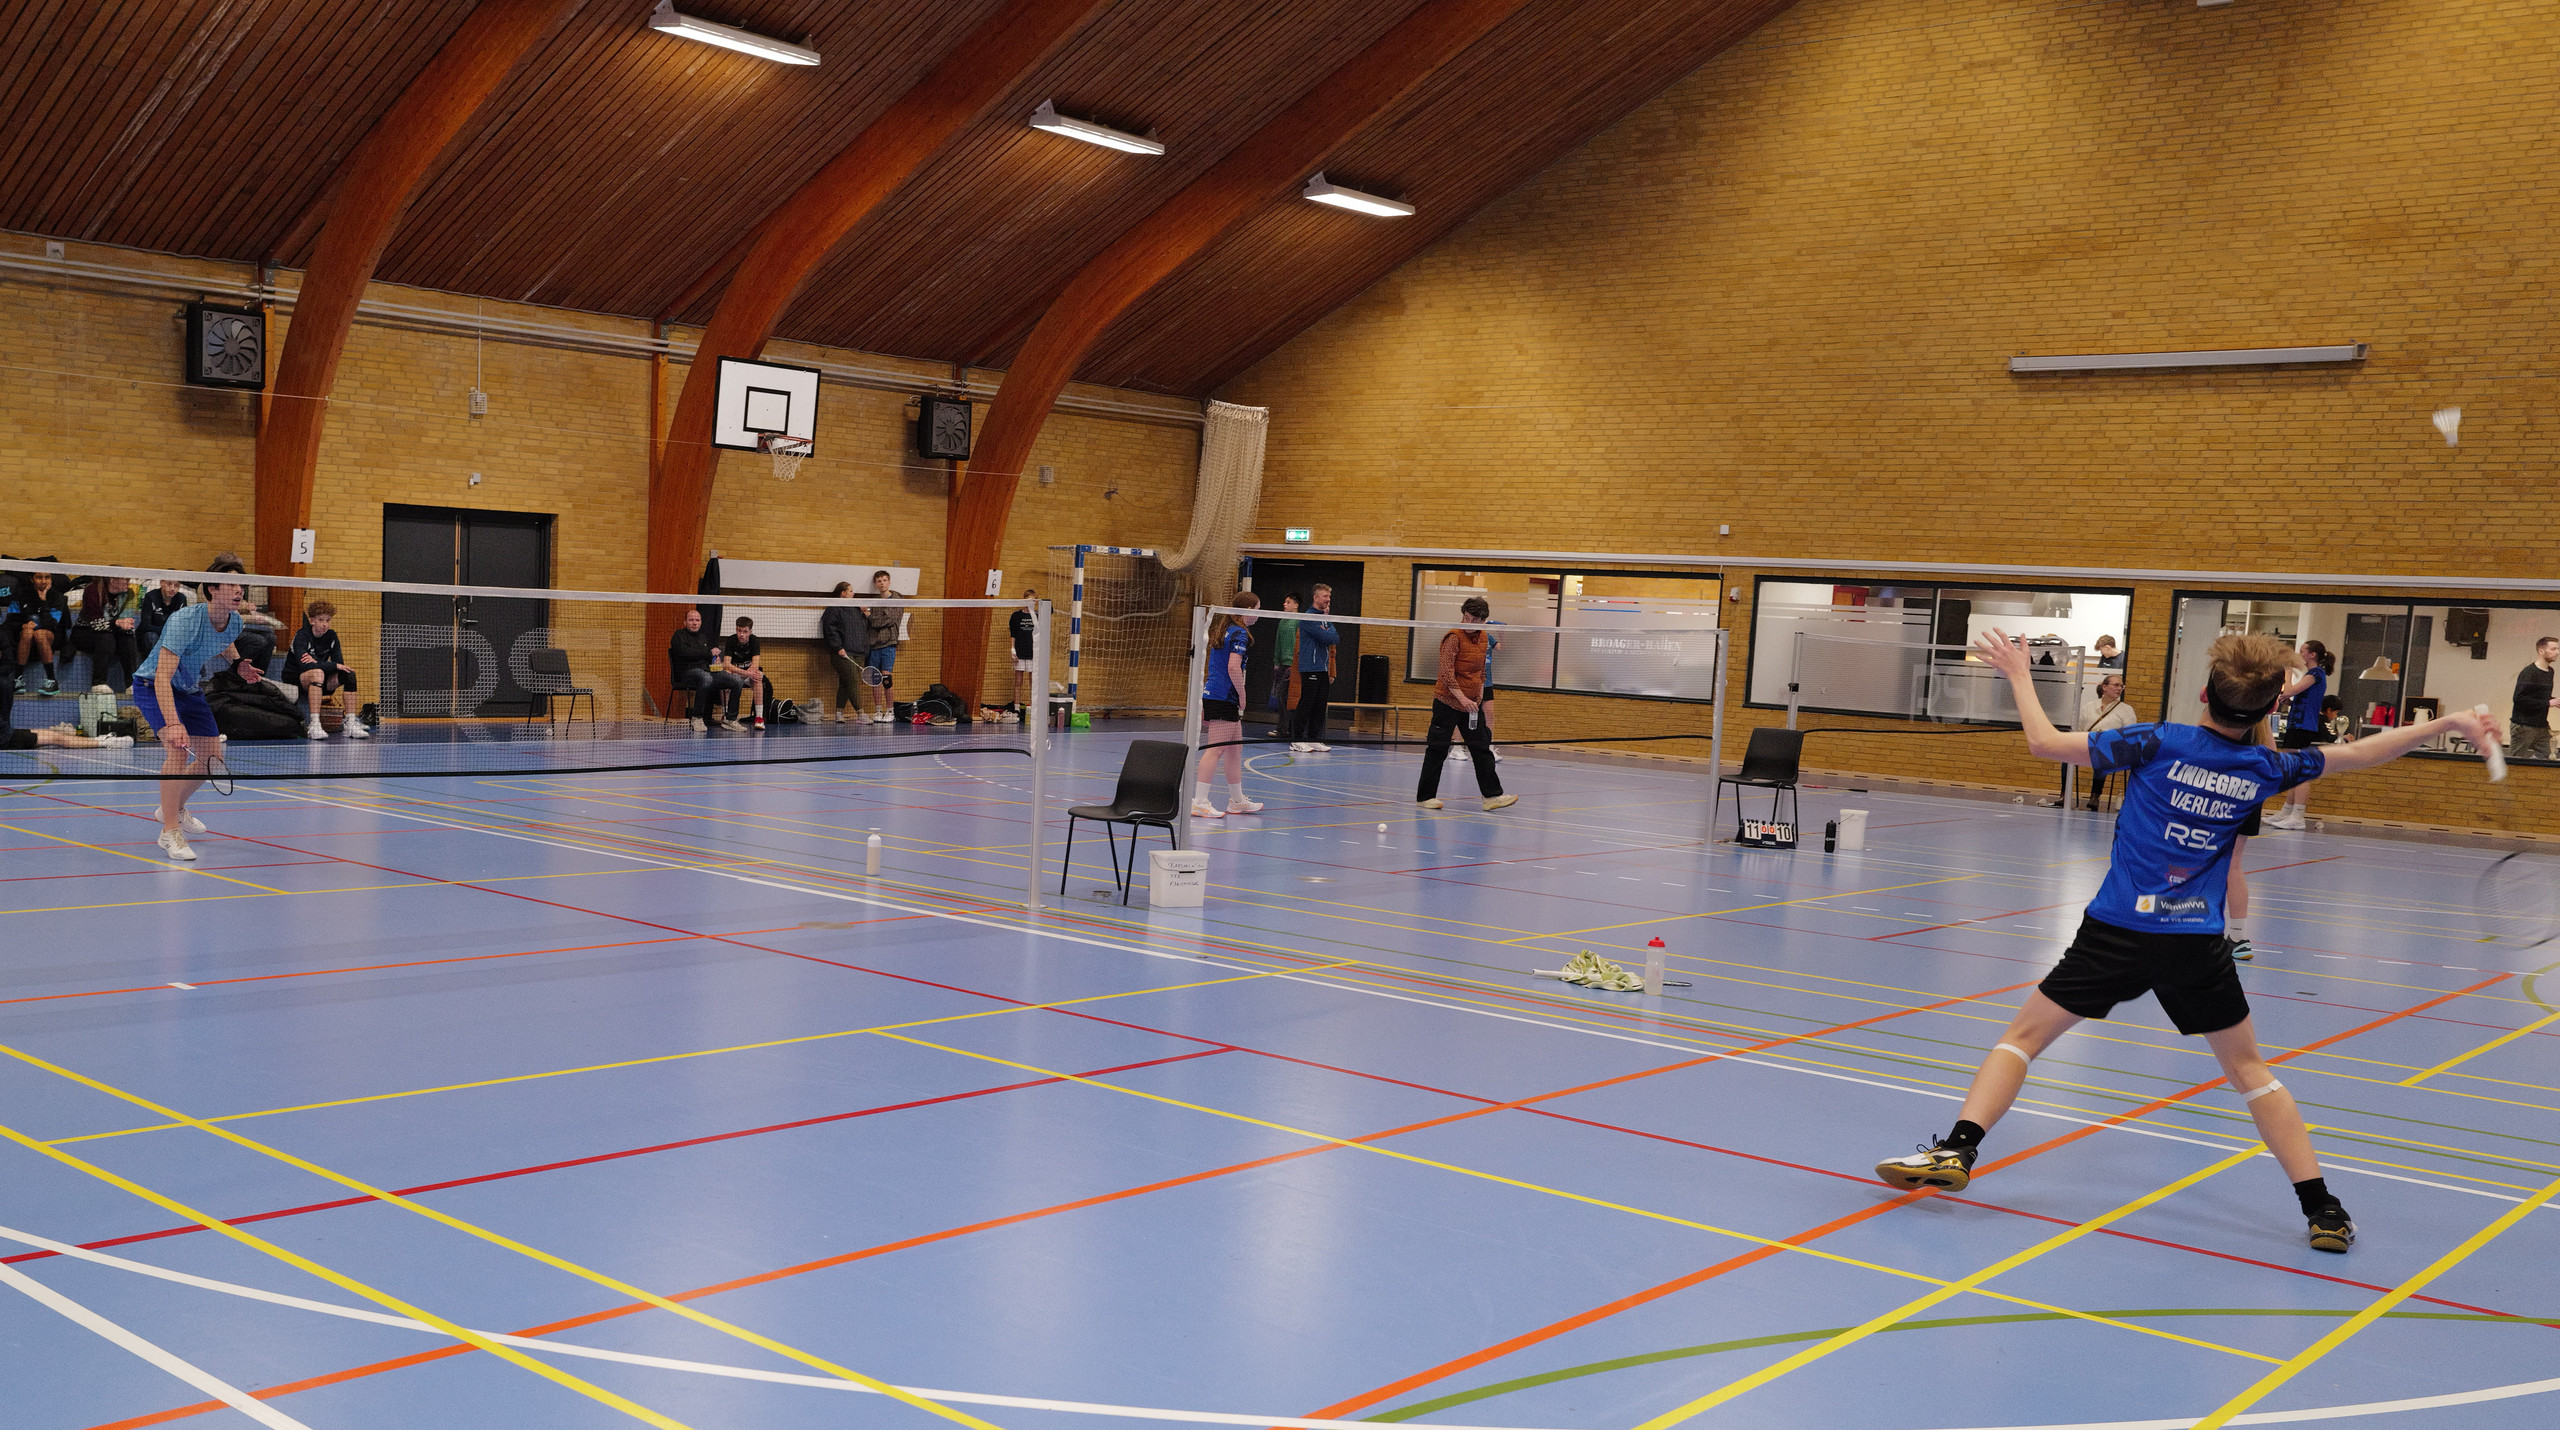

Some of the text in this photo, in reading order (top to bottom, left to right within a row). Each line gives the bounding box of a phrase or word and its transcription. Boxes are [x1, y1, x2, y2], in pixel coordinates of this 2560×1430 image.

[300, 541, 308, 554] 5
[991, 579, 997, 589] 6
[2166, 760, 2260, 801] LINDEGREN
[2170, 788, 2237, 819] VÆRLØSE
[1747, 824, 1759, 837] 11
[1777, 826, 1791, 840] 10
[2164, 822, 2217, 850] RSL
